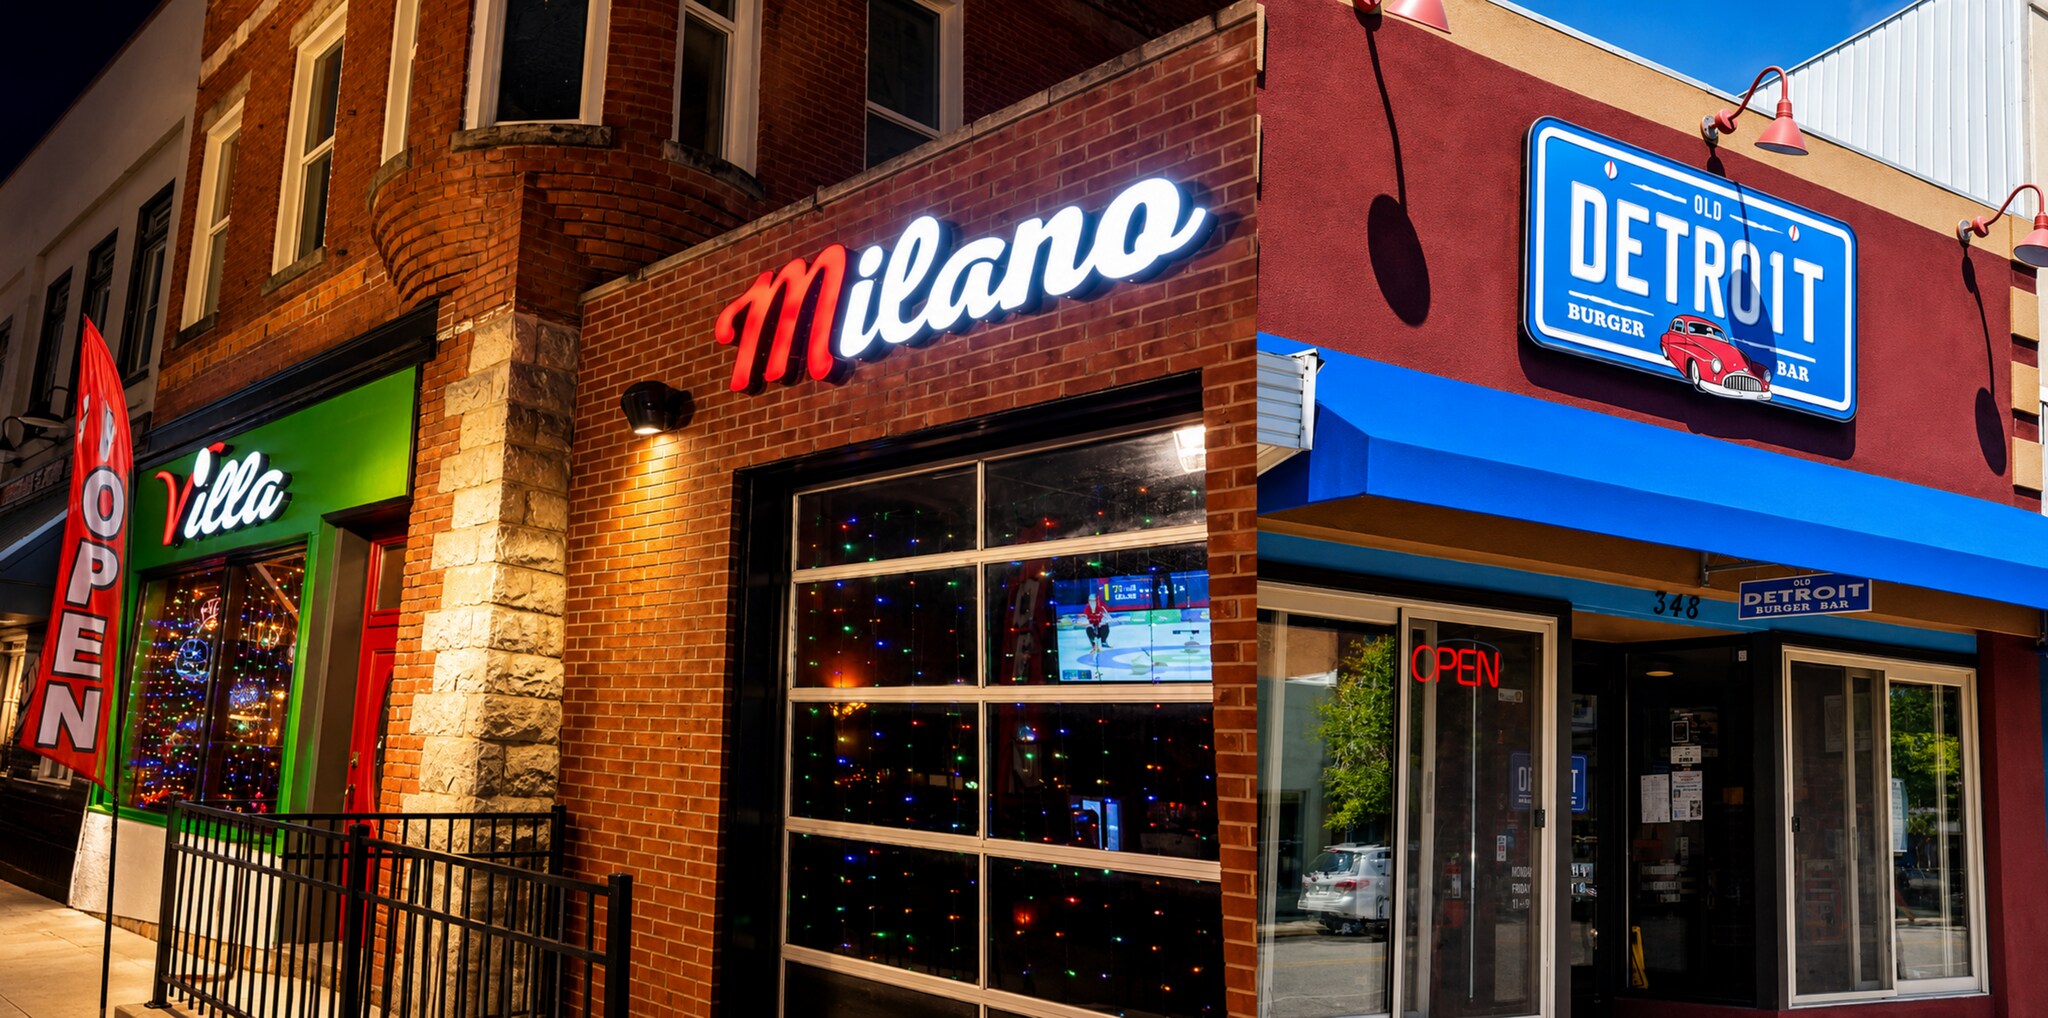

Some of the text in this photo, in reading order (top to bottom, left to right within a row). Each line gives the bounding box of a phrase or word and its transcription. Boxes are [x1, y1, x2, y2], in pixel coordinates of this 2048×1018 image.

[1694, 194, 1722, 221] OLD
[1570, 180, 1824, 343] DETROIT
[714, 177, 1207, 393] Milano
[1568, 302, 1810, 382] BURGER BAR
[154, 441, 284, 546] Villa
[1653, 589, 1700, 620] 348
[1744, 583, 1865, 606] DETROIT
[1794, 578, 1811, 587] OLD
[35, 465, 126, 753] OPEN
[1755, 600, 1849, 615] BURGER BAR
[1411, 644, 1500, 688] OPEN
